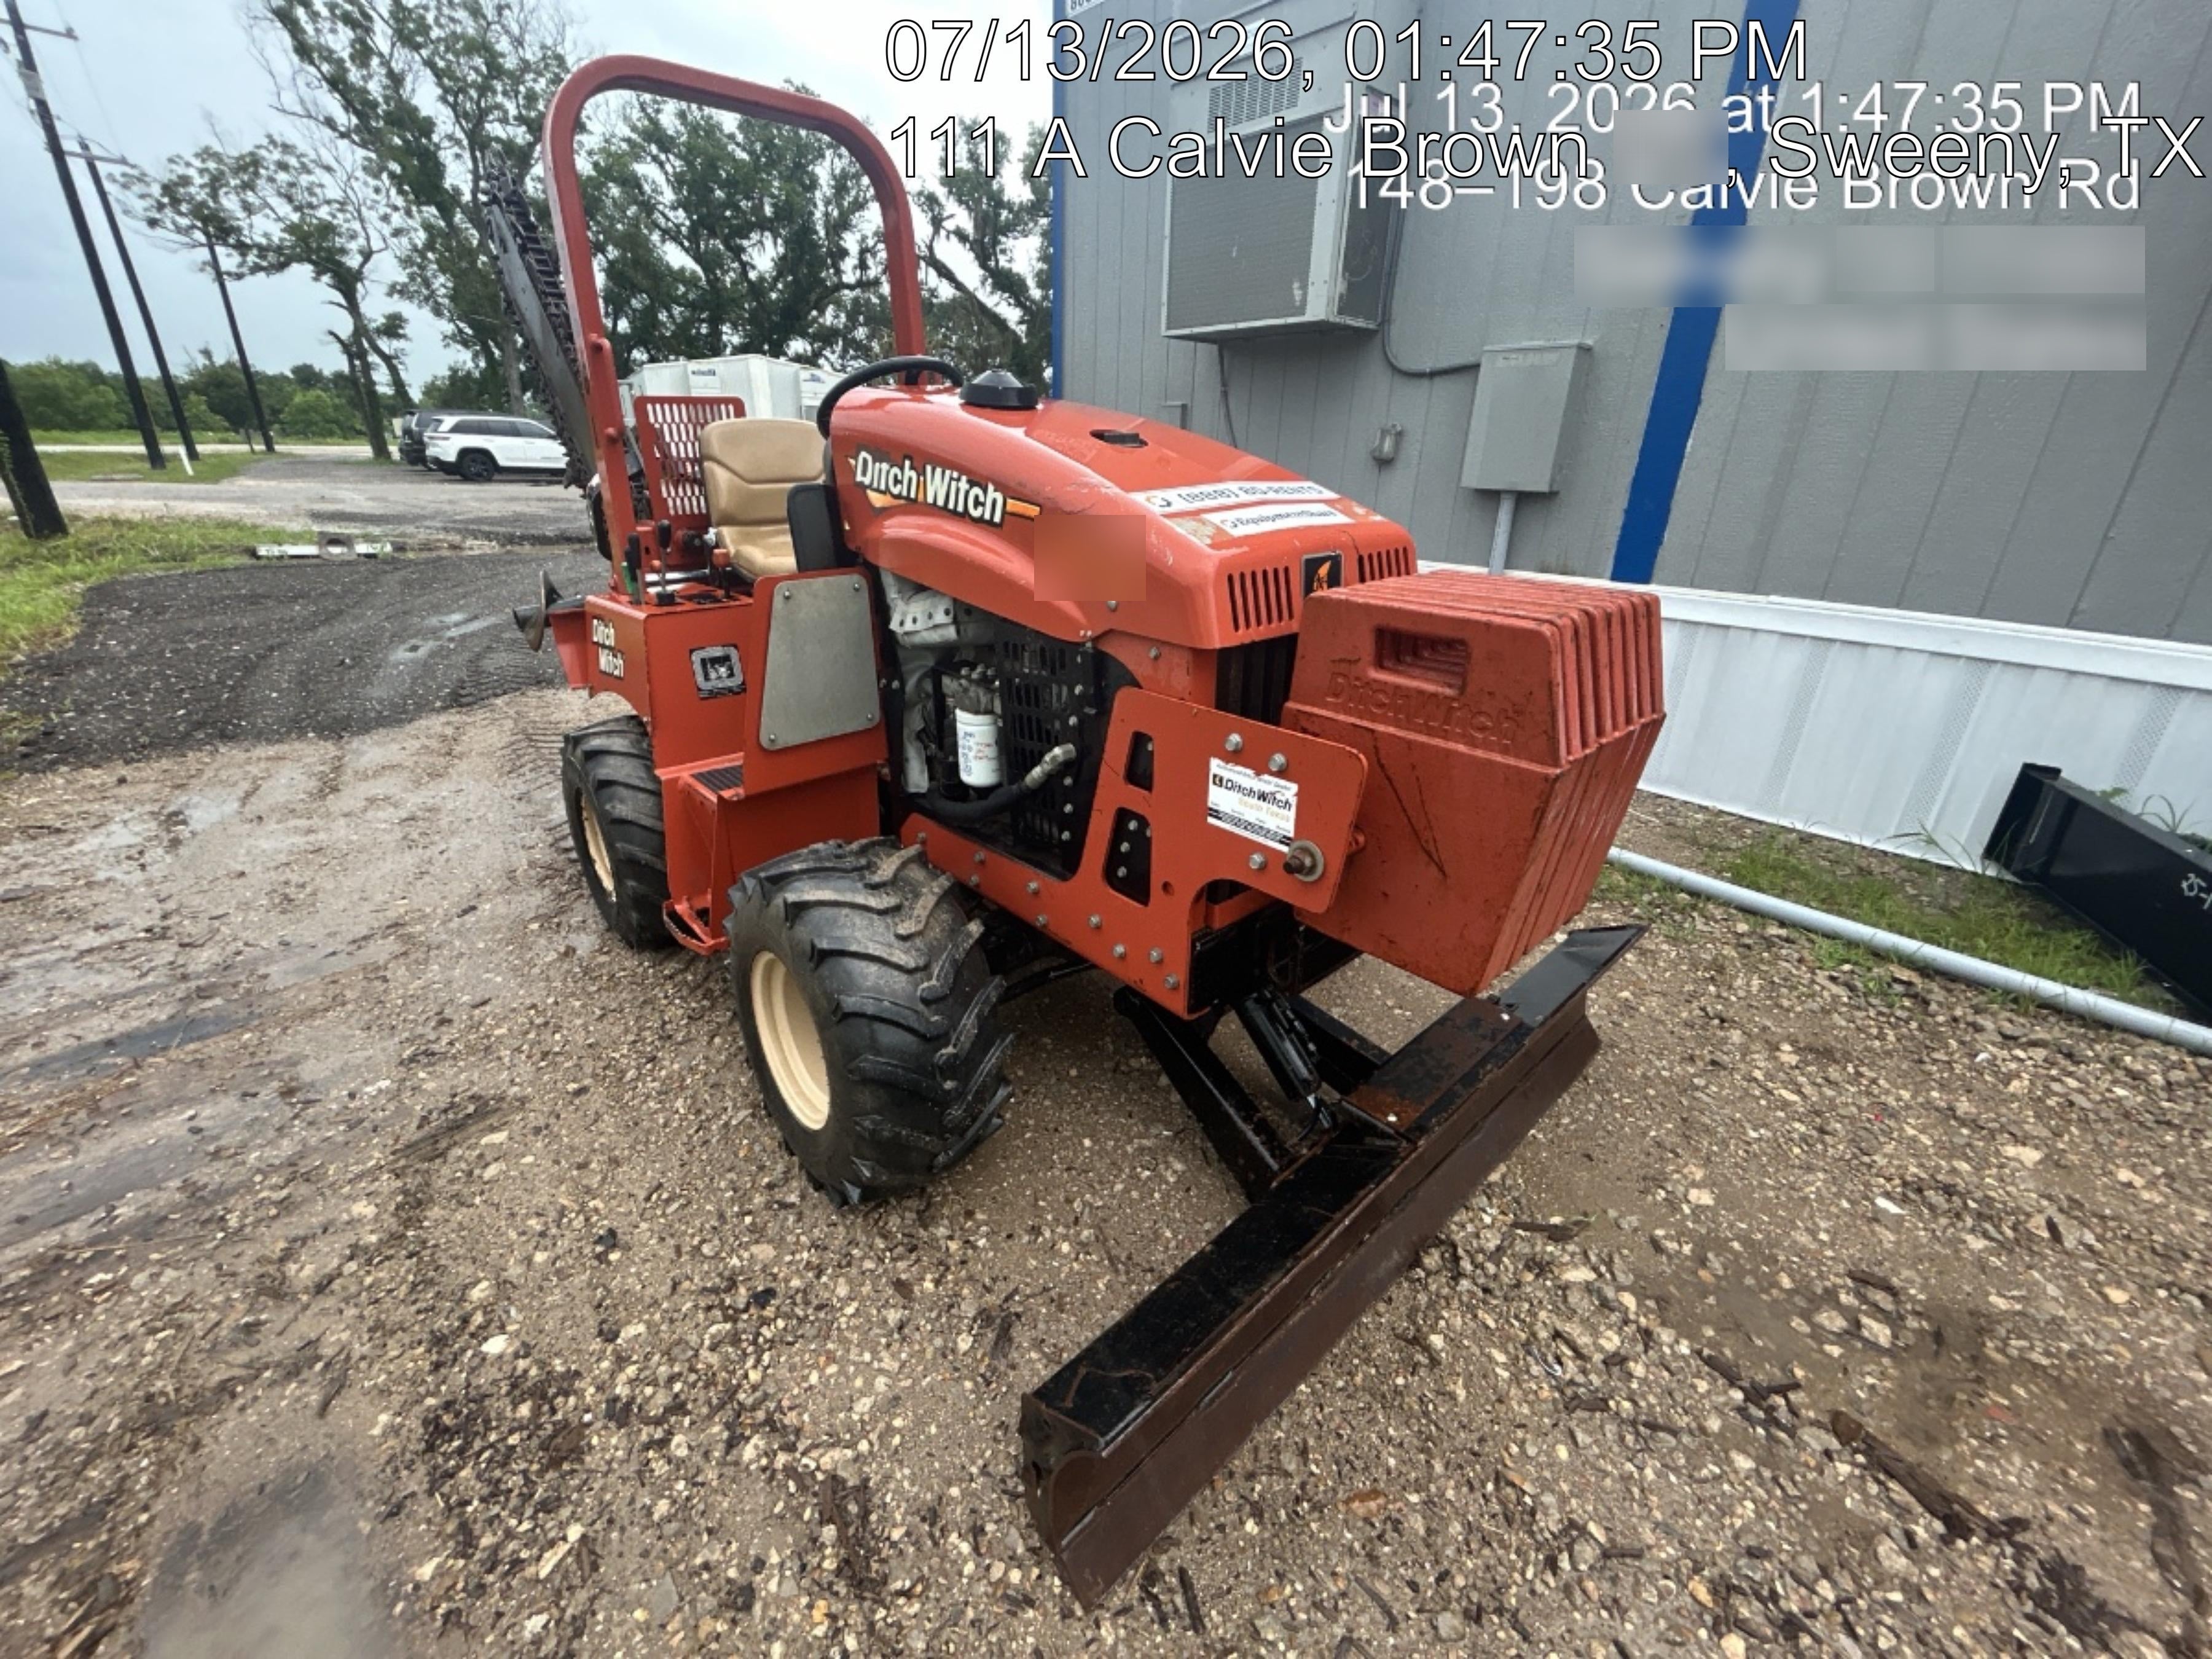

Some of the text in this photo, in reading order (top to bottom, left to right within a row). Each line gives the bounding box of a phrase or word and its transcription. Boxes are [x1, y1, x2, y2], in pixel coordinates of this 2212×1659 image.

[924, 463, 1003, 524] Witch
[592, 619, 614, 647] Ditch
[598, 646, 624, 677] Witch
